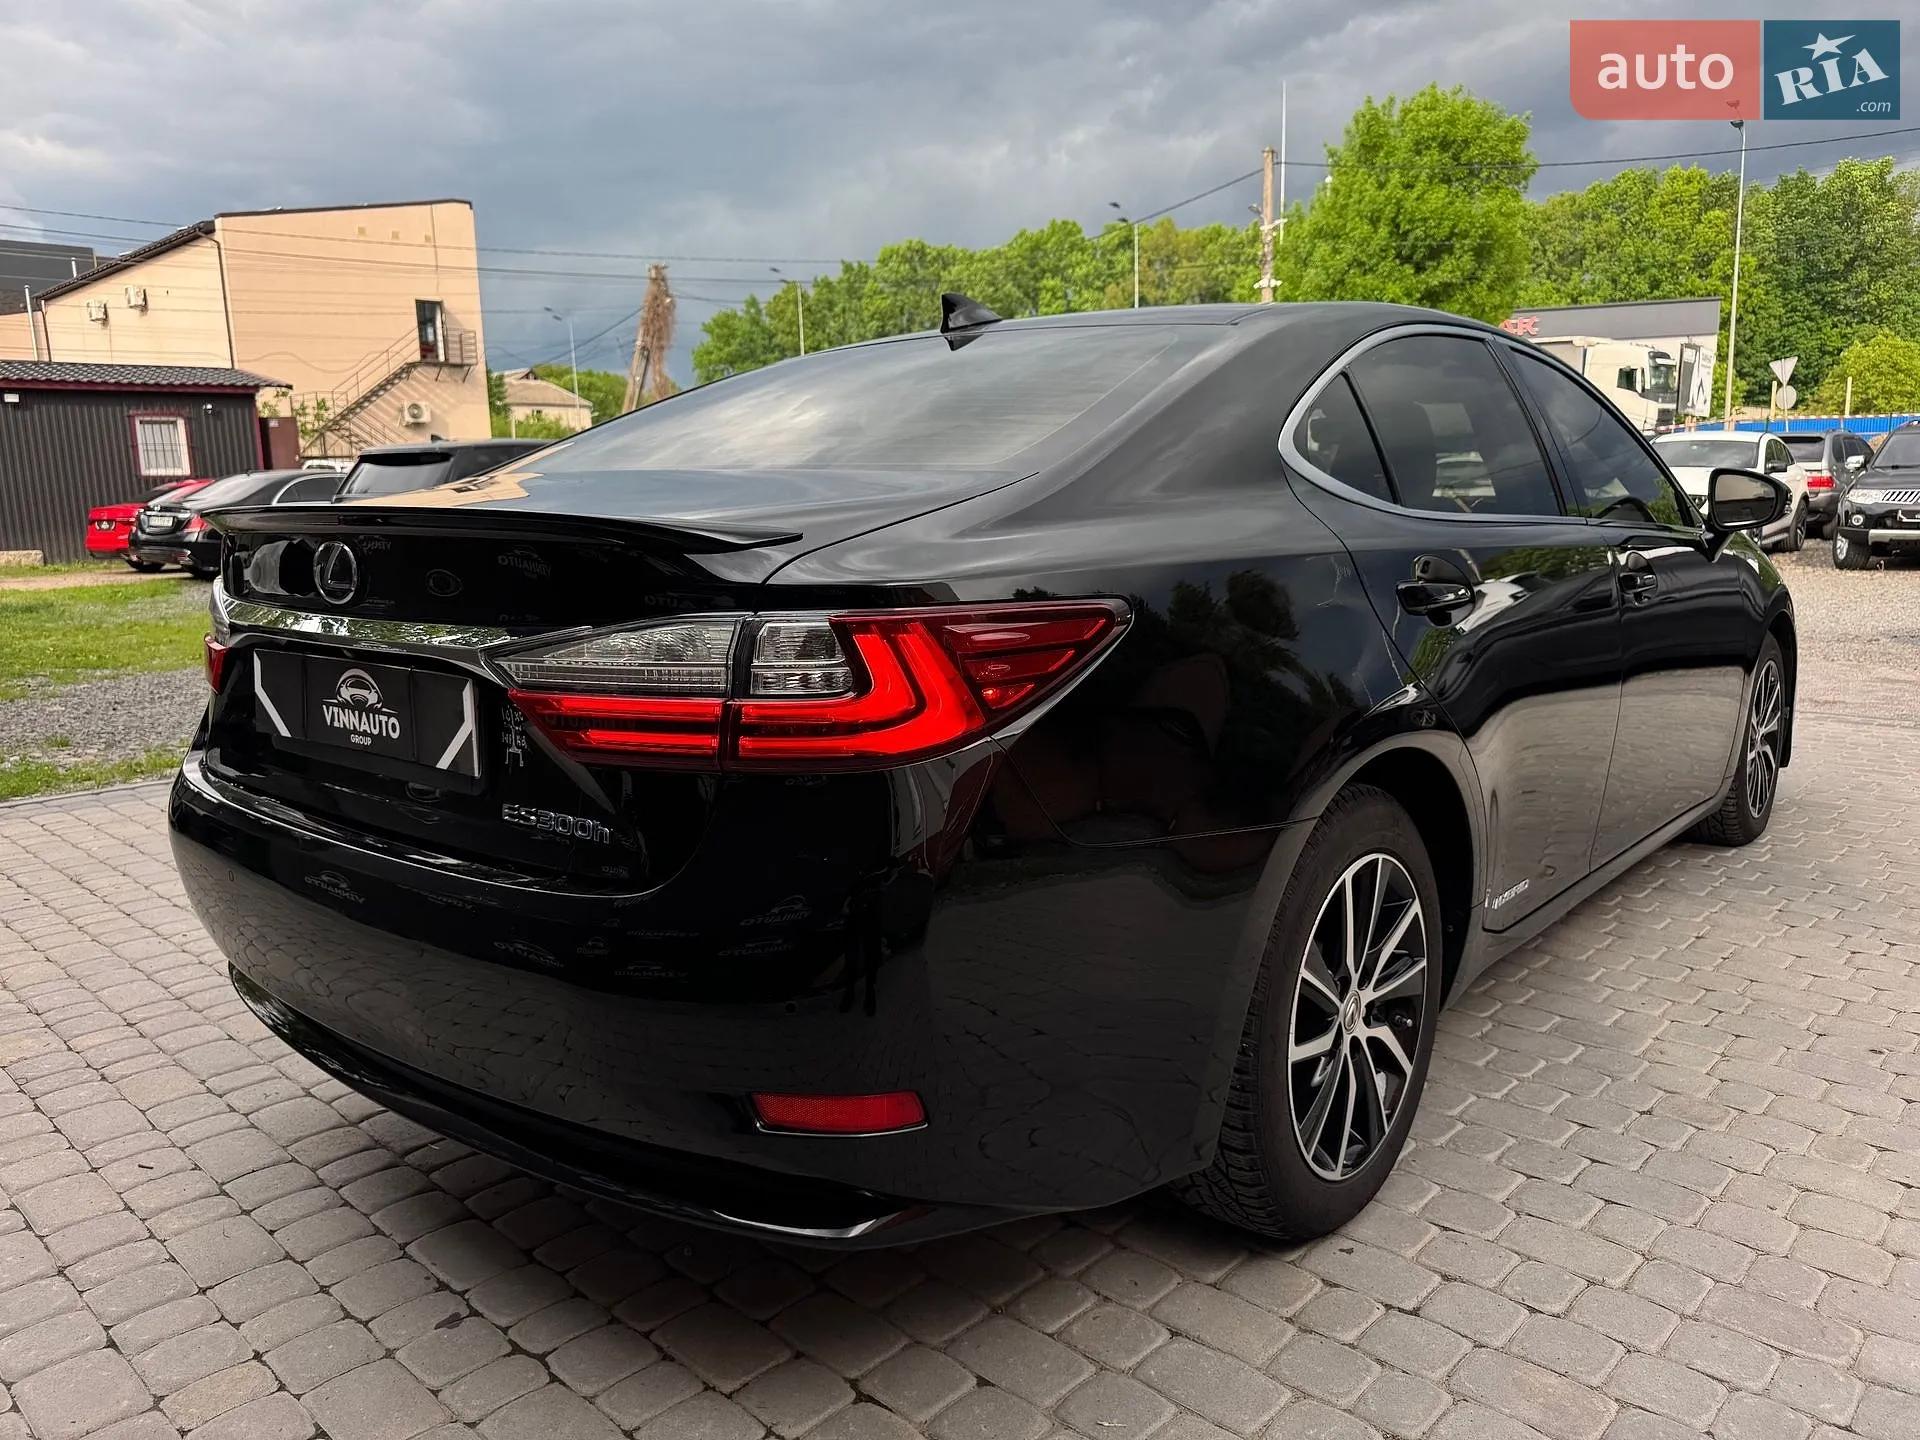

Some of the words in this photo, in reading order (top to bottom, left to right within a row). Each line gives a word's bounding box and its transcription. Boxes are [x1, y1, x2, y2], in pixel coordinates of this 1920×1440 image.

[322, 704, 401, 739] VINNAUTO
[350, 733, 373, 746] GROUP
[502, 803, 610, 844] ES300h
